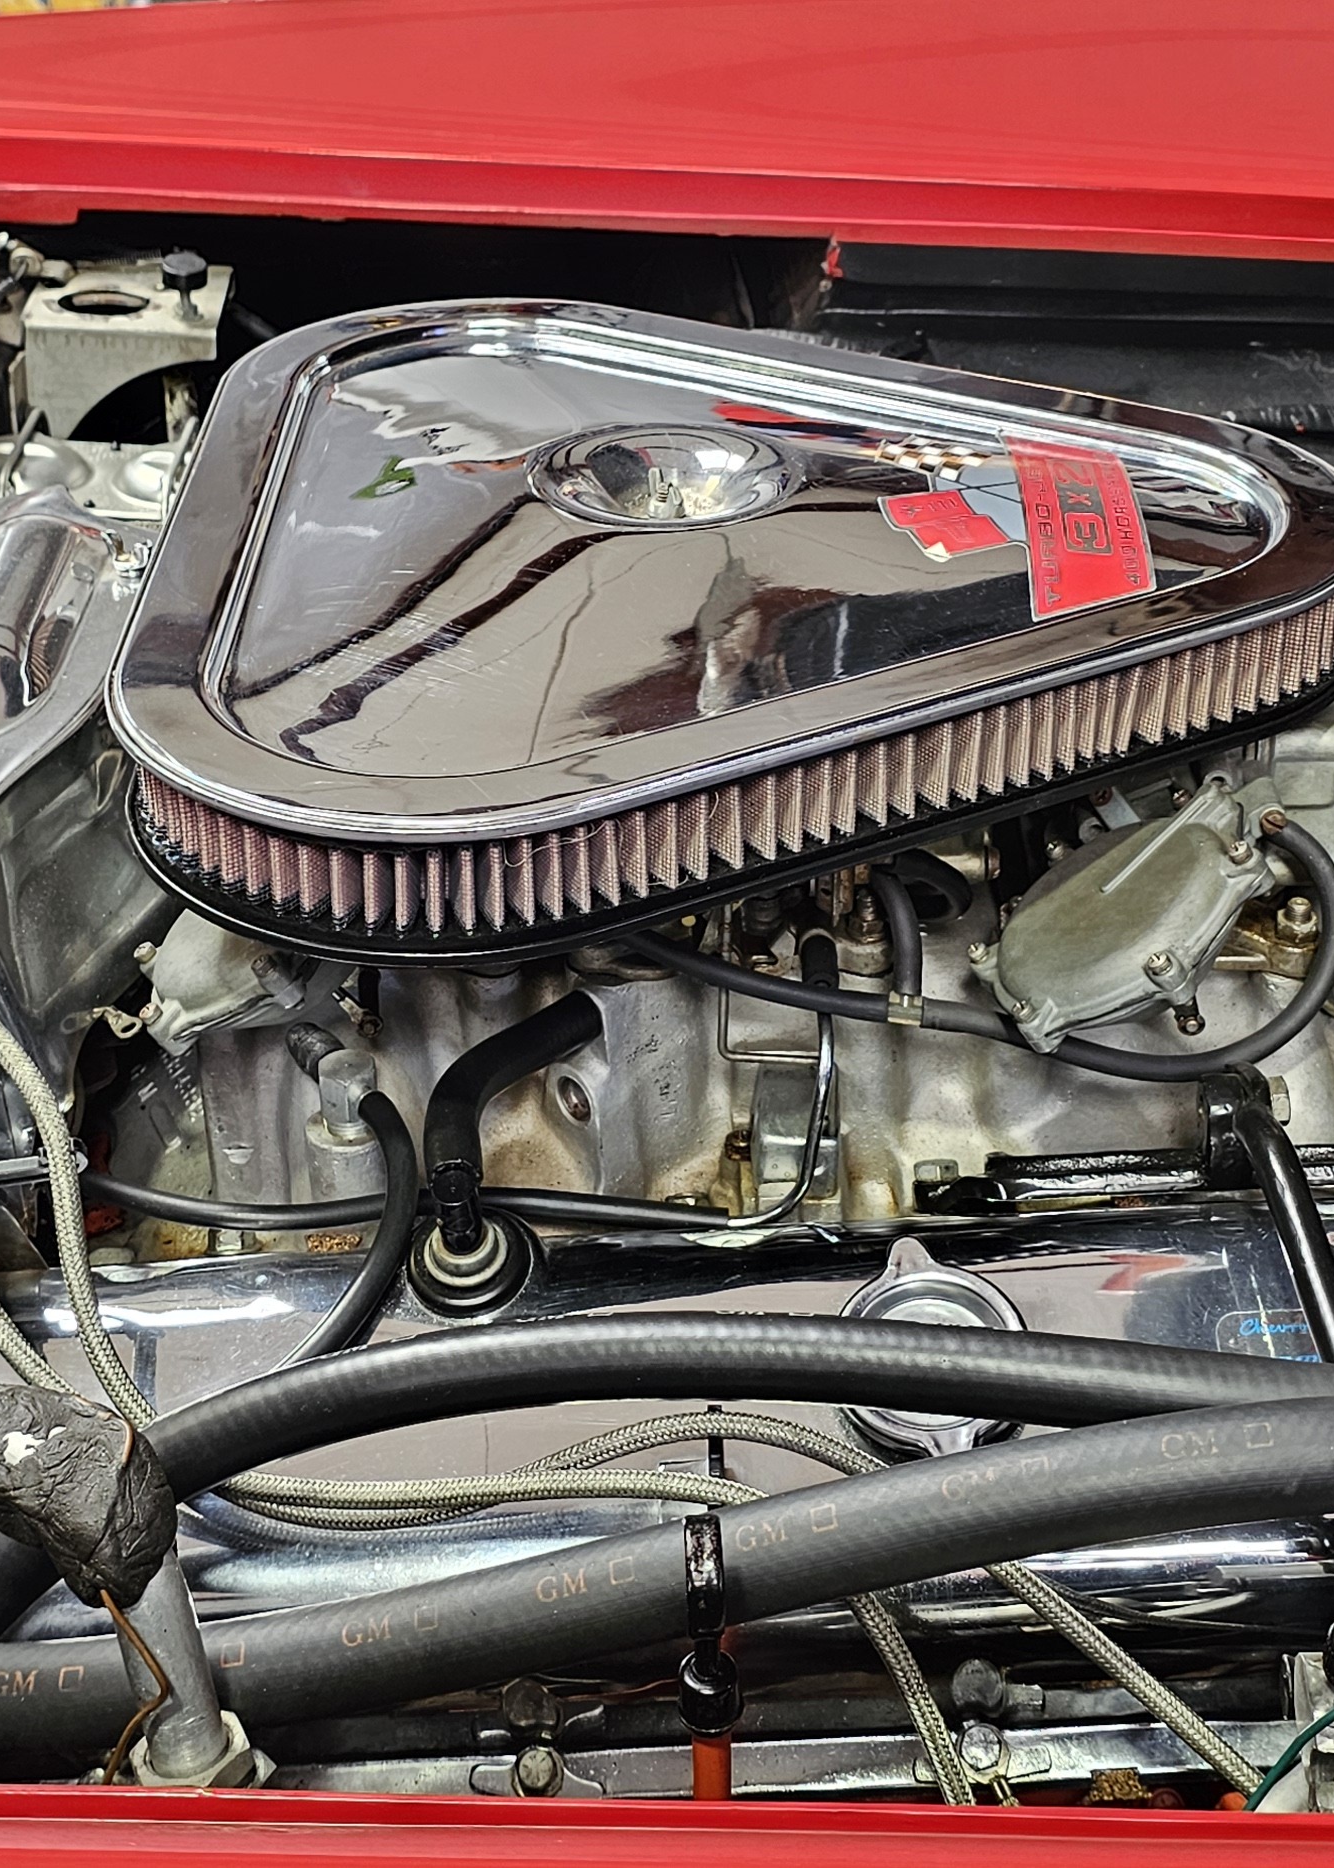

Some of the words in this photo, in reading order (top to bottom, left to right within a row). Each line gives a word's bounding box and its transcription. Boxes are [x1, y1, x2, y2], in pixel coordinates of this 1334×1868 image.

[1022, 459, 1061, 606] TURBO-JE
[1121, 545, 1141, 585] 400
[735, 1510, 788, 1551] GM
[536, 1568, 588, 1602] GM
[342, 1615, 391, 1647] GM
